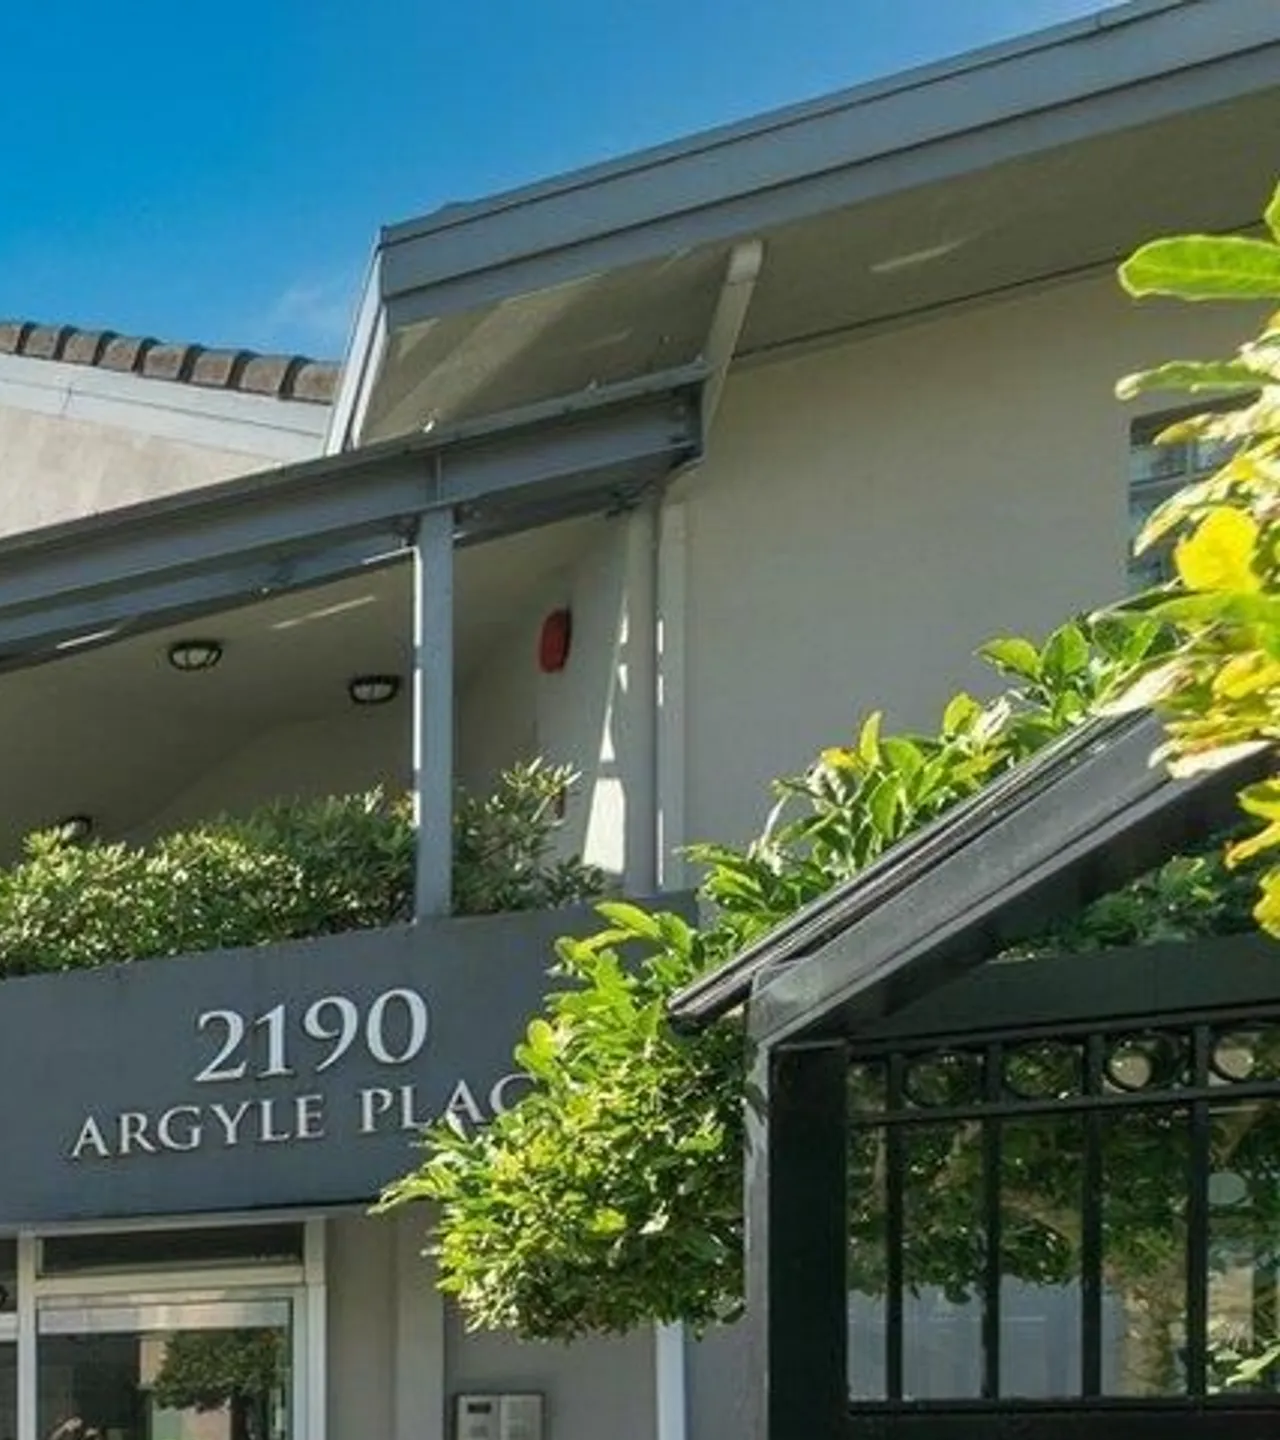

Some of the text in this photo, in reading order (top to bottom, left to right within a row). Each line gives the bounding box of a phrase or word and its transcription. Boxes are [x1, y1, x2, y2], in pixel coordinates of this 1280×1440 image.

[193, 987, 430, 1083] 2190
[69, 1073, 538, 1159] ARGYLE PLAC
